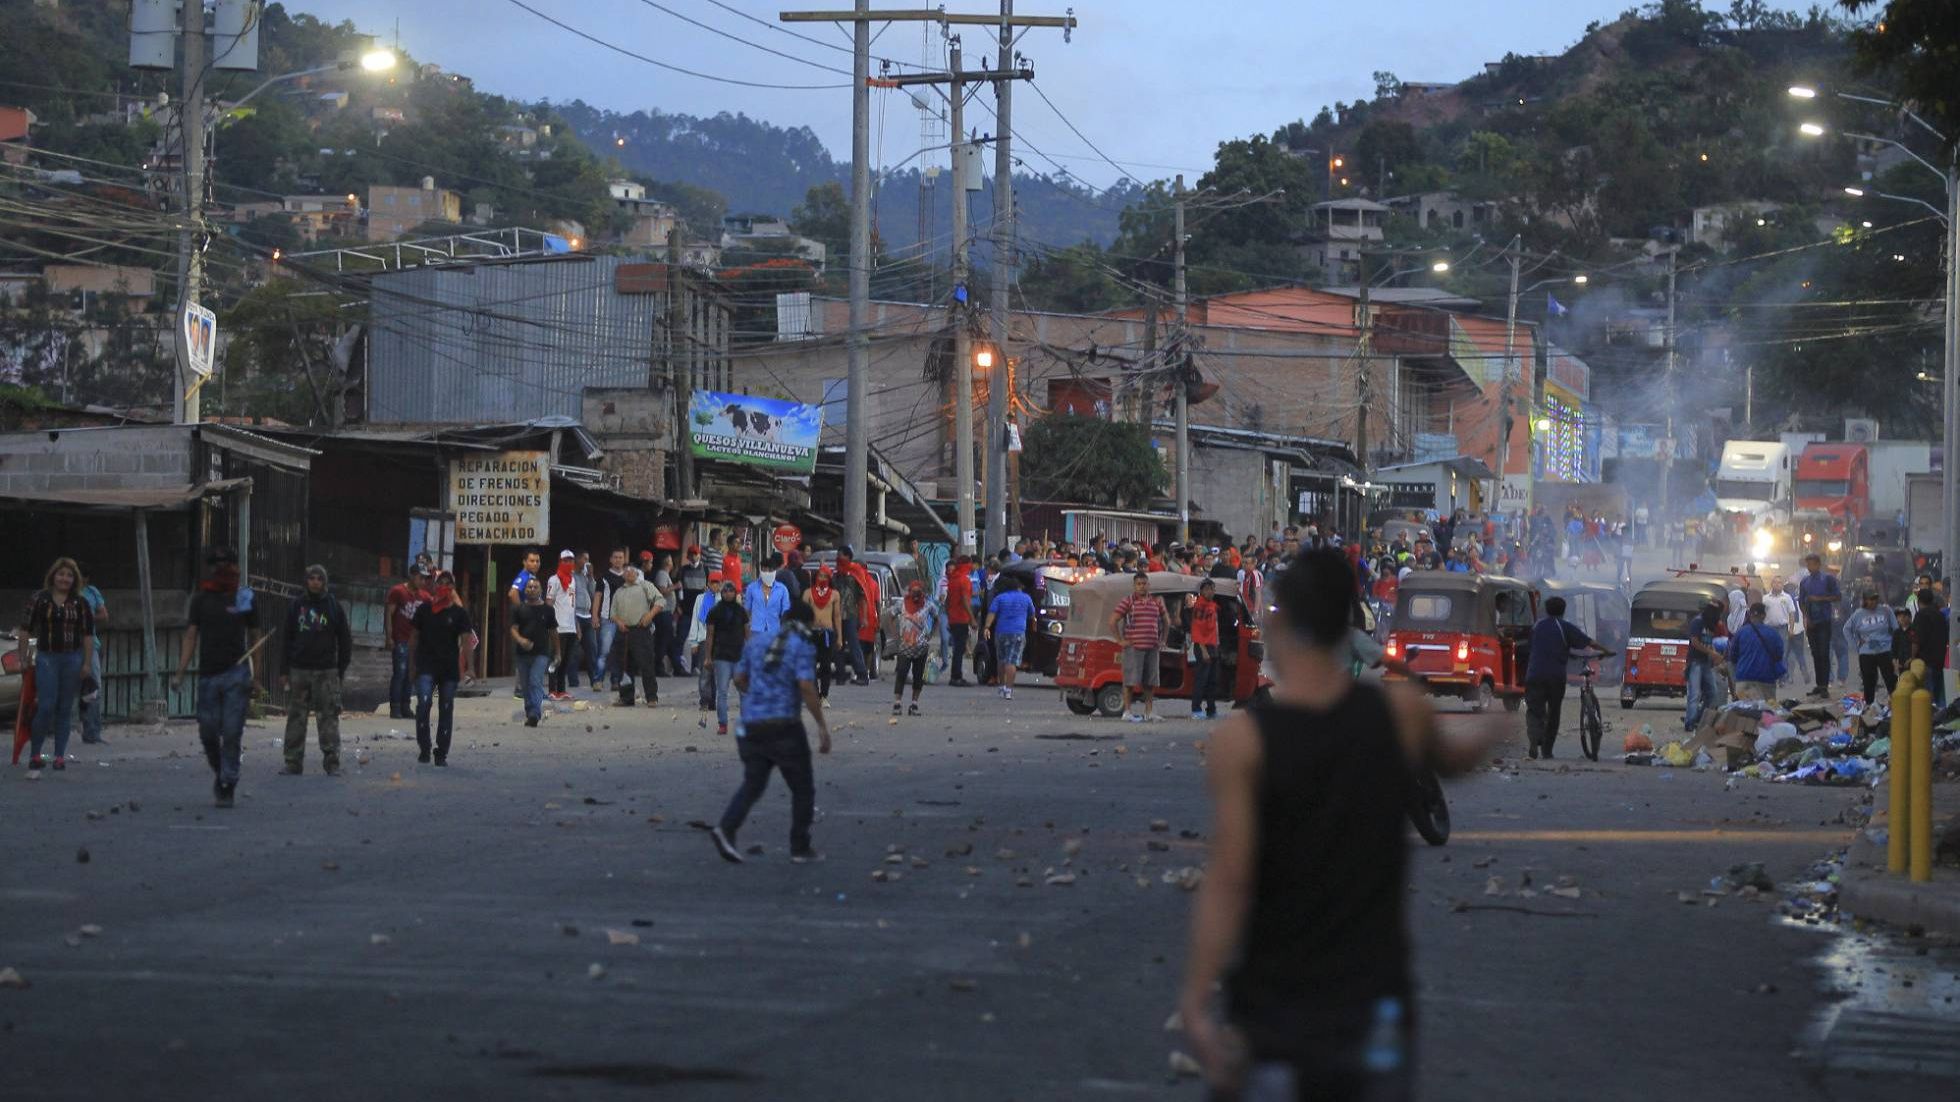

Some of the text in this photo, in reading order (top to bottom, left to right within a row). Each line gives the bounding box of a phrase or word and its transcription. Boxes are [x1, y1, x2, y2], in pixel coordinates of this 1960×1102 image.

[693, 433, 809, 457] QUESOS VILLANUEVA
[706, 444, 741, 455] LACTEOS
[458, 460, 538, 472] REPARACION
[458, 478, 542, 490] DE FRENOS Y
[458, 495, 541, 506] DIRECCIONES
[460, 512, 524, 522] PEGADO Y
[458, 528, 535, 539] REMACHADO
[774, 533, 797, 543] Claro
